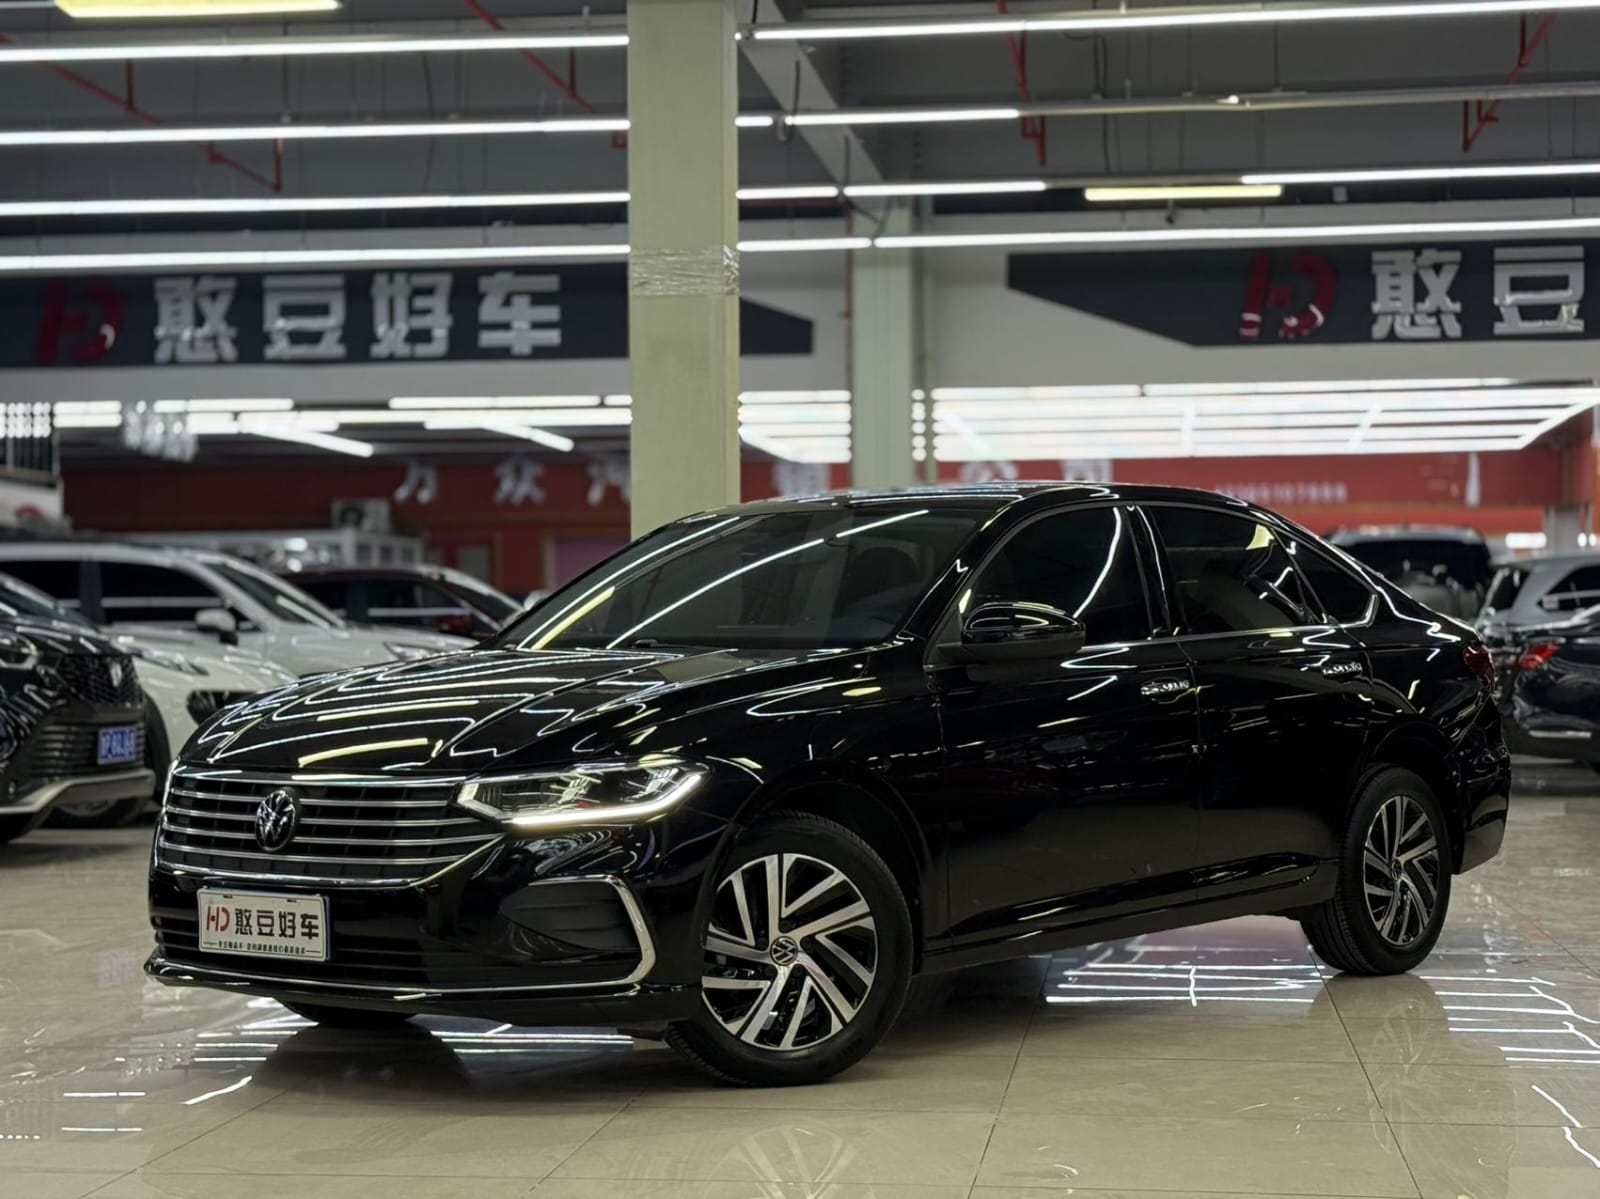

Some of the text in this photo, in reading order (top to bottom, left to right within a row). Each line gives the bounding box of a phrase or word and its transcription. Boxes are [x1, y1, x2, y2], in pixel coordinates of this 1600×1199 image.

[154, 271, 562, 363] 憨豆好车
[1371, 246, 1584, 339] 憨豆
[234, 908, 320, 940] 憨豆好车
